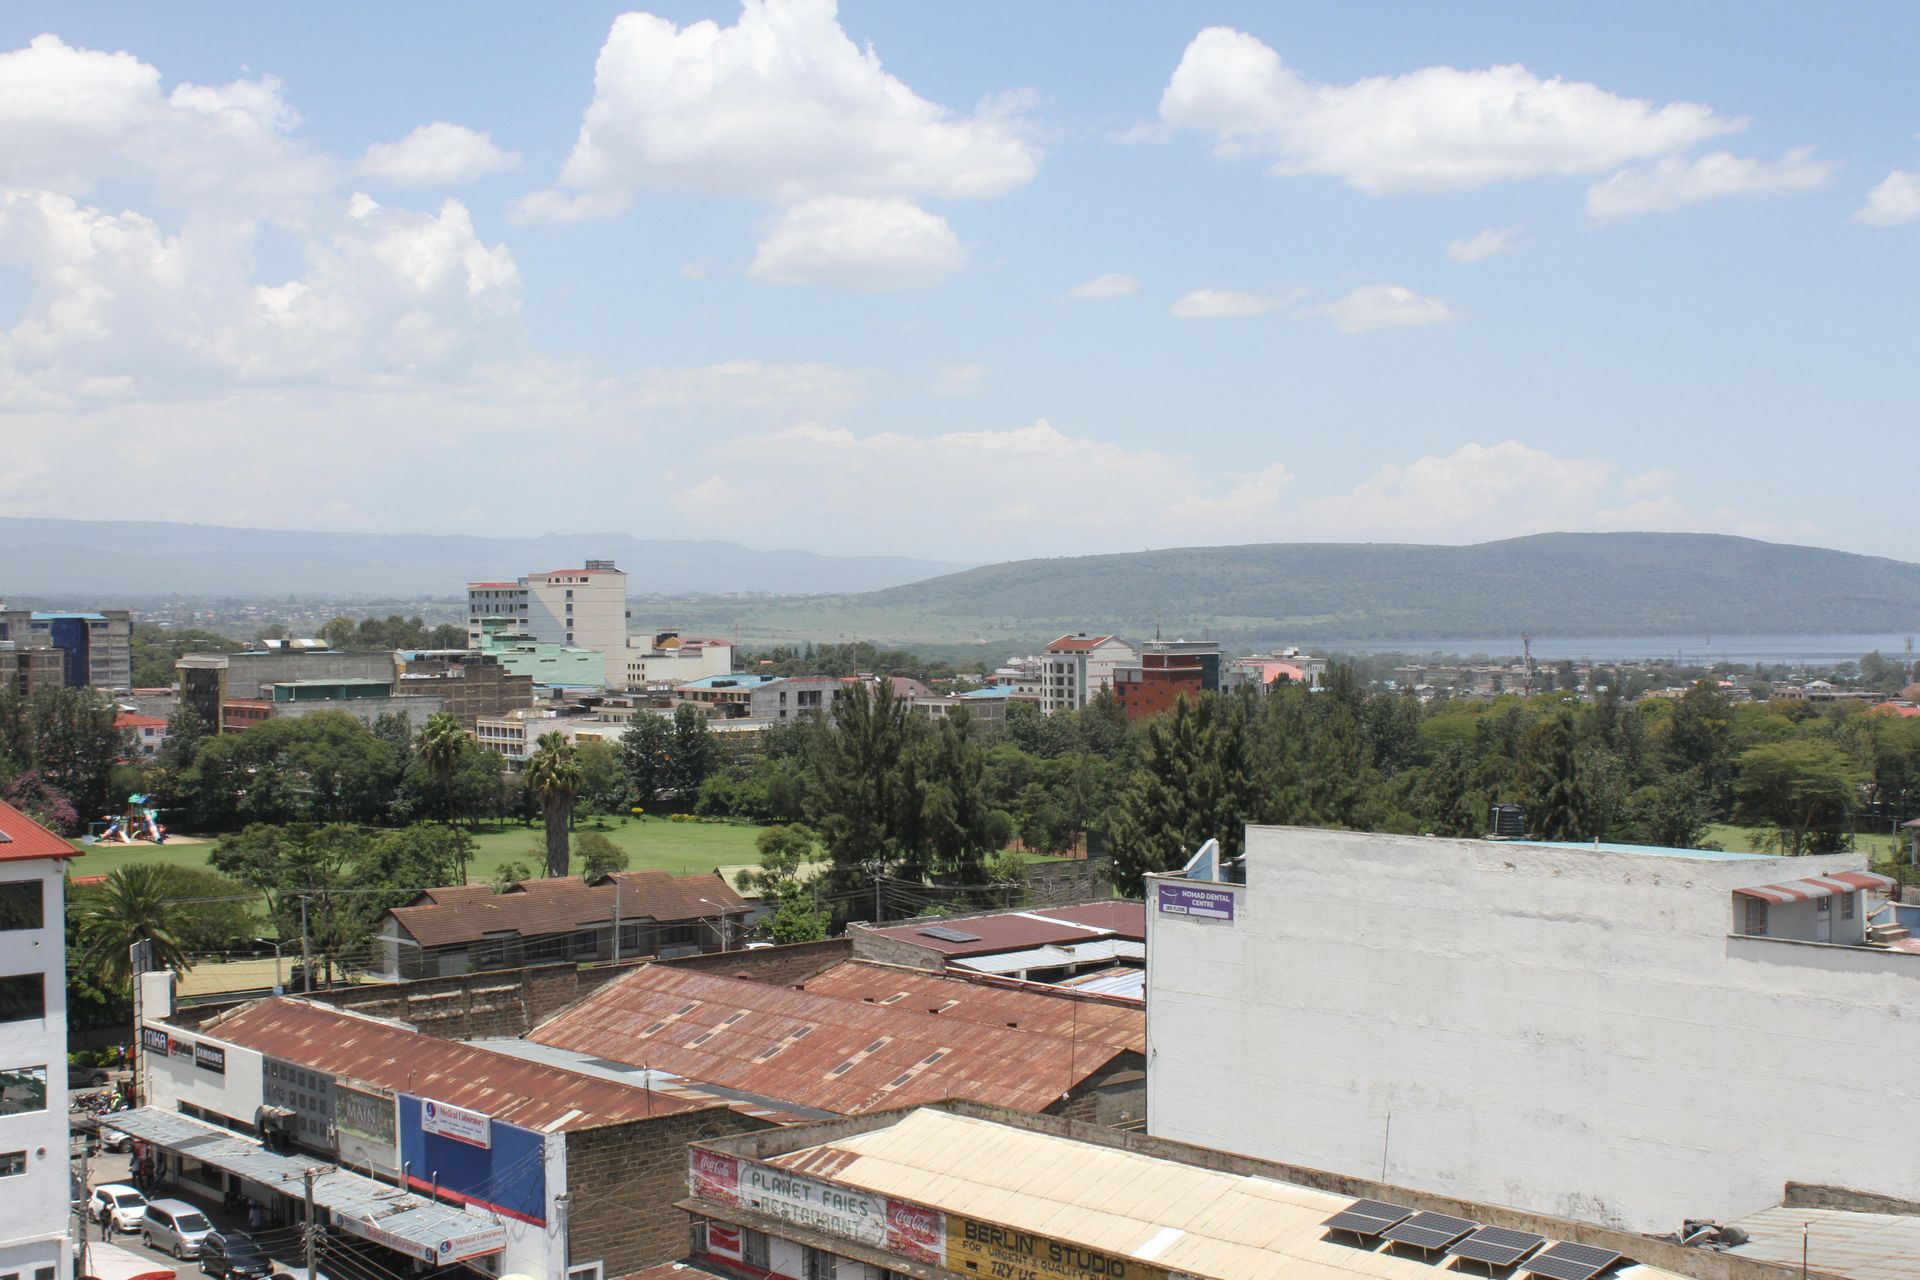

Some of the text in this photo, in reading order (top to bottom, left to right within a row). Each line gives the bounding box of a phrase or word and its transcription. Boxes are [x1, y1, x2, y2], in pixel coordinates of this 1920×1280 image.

[1182, 890, 1230, 902] NOMAD DENTAL
[144, 1030, 166, 1049] MIKA
[196, 1047, 223, 1064] SAMSUNG
[440, 1106, 458, 1120] Medical
[458, 1112, 485, 1129] Laboratory
[701, 1156, 729, 1177] Coca-Cola
[752, 1171, 811, 1201] PLANET
[895, 1210, 929, 1234] Coca-Cola
[363, 1223, 421, 1257] Medical Laboratory
[455, 1229, 505, 1245] Medical Laboratory
[962, 1240, 982, 1253] FOR
[988, 1246, 1028, 1265] URGENT
[1041, 1260, 1085, 1280] QUALITY
[965, 1221, 1125, 1278] BERLIN STUDIO
[991, 1260, 1015, 1279] TRY
